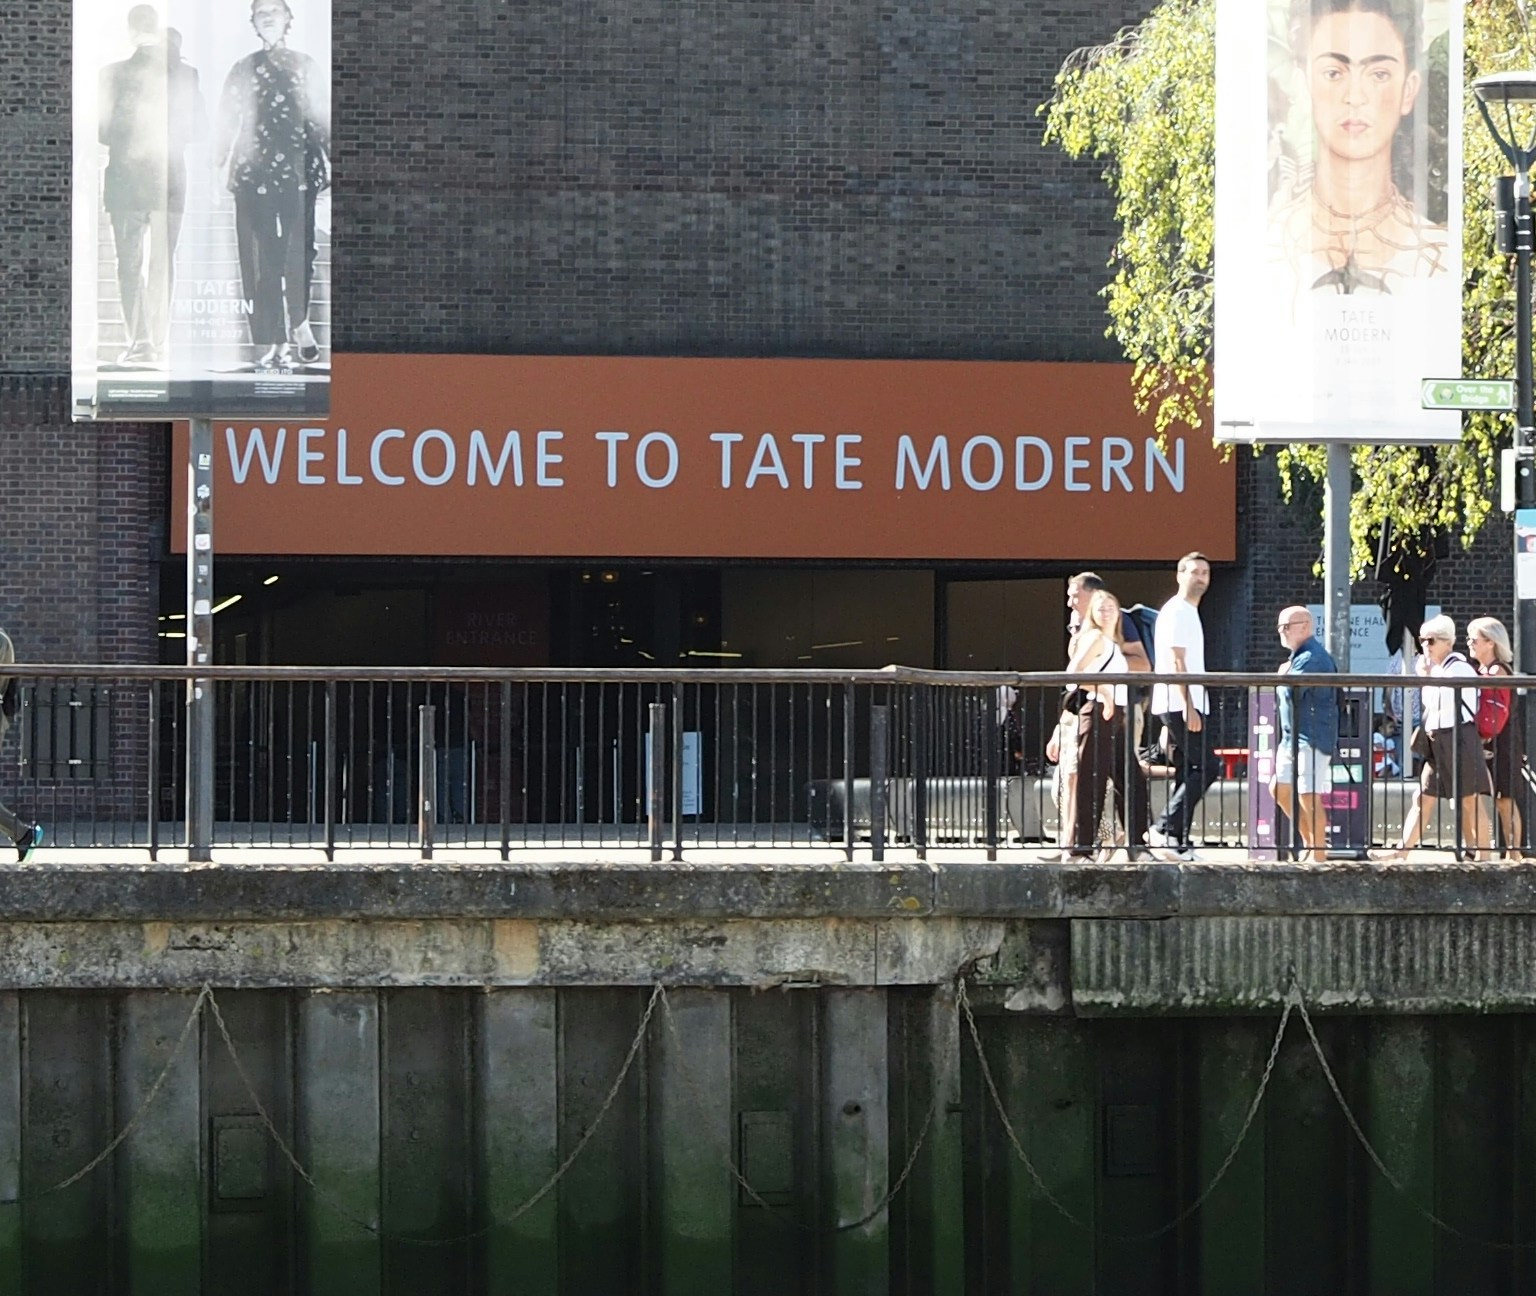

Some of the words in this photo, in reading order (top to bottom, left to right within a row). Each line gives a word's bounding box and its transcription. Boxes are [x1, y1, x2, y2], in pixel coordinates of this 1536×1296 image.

[194, 279, 235, 296] TATE
[176, 299, 254, 315] MODERN
[1341, 310, 1376, 325] TATE
[1325, 328, 1391, 342] MODERN
[225, 427, 565, 487] WELCOME
[595, 431, 679, 489] TO
[711, 433, 863, 490] TATE
[895, 435, 1186, 493] MODERN
[446, 630, 537, 645] ENTRANCE
